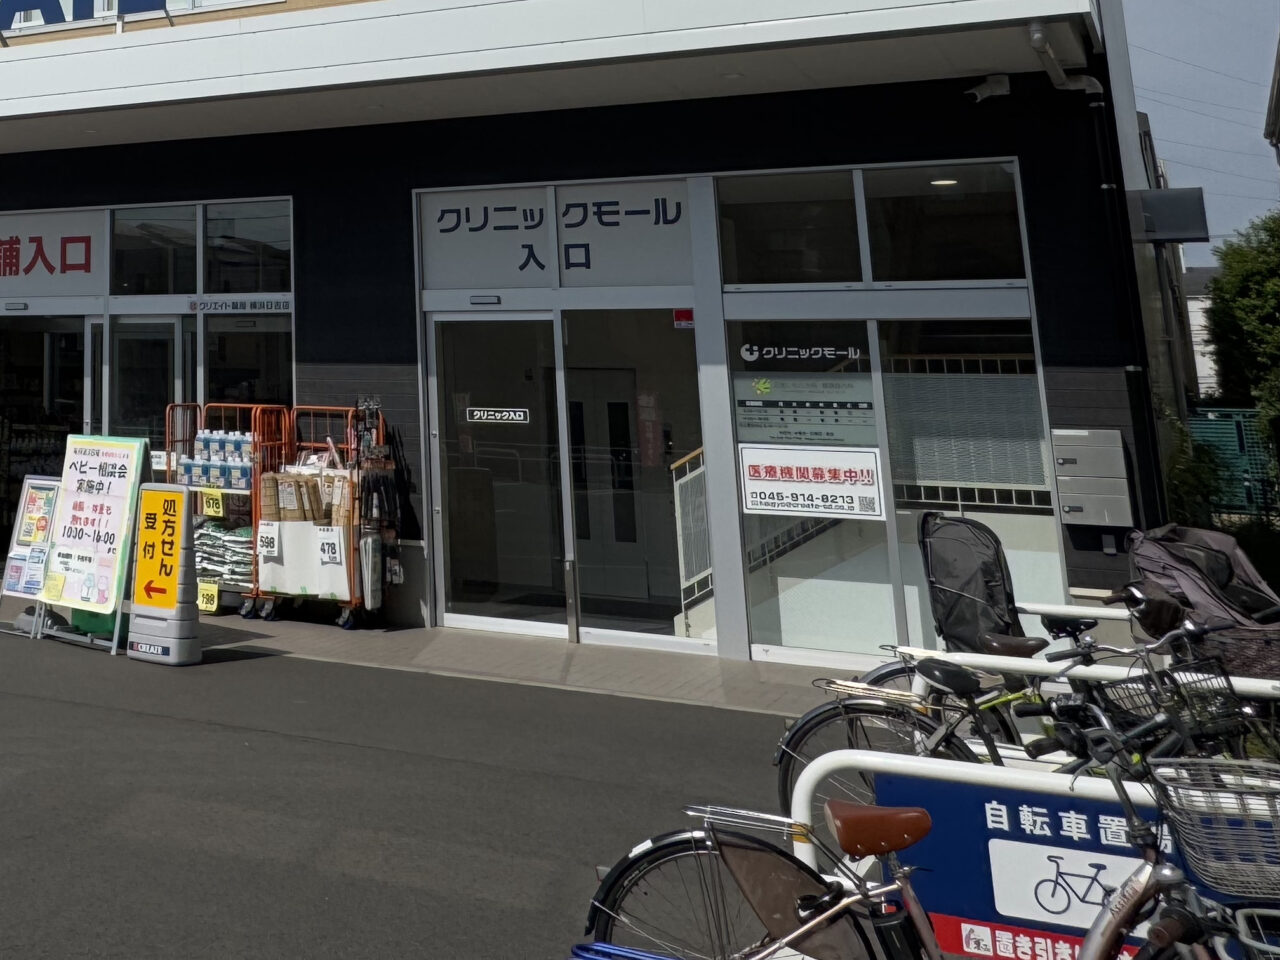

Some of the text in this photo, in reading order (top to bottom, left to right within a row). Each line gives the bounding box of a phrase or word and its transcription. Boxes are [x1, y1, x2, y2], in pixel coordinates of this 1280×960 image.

[437, 197, 682, 232] クリニックモール
[519, 243, 592, 272] 入口
[763, 347, 859, 359] クリニックモール
[473, 411, 524, 420] クリニック入口
[143, 512, 157, 560] 受付
[159, 499, 177, 577] 処方せん
[320, 542, 336, 555] 478
